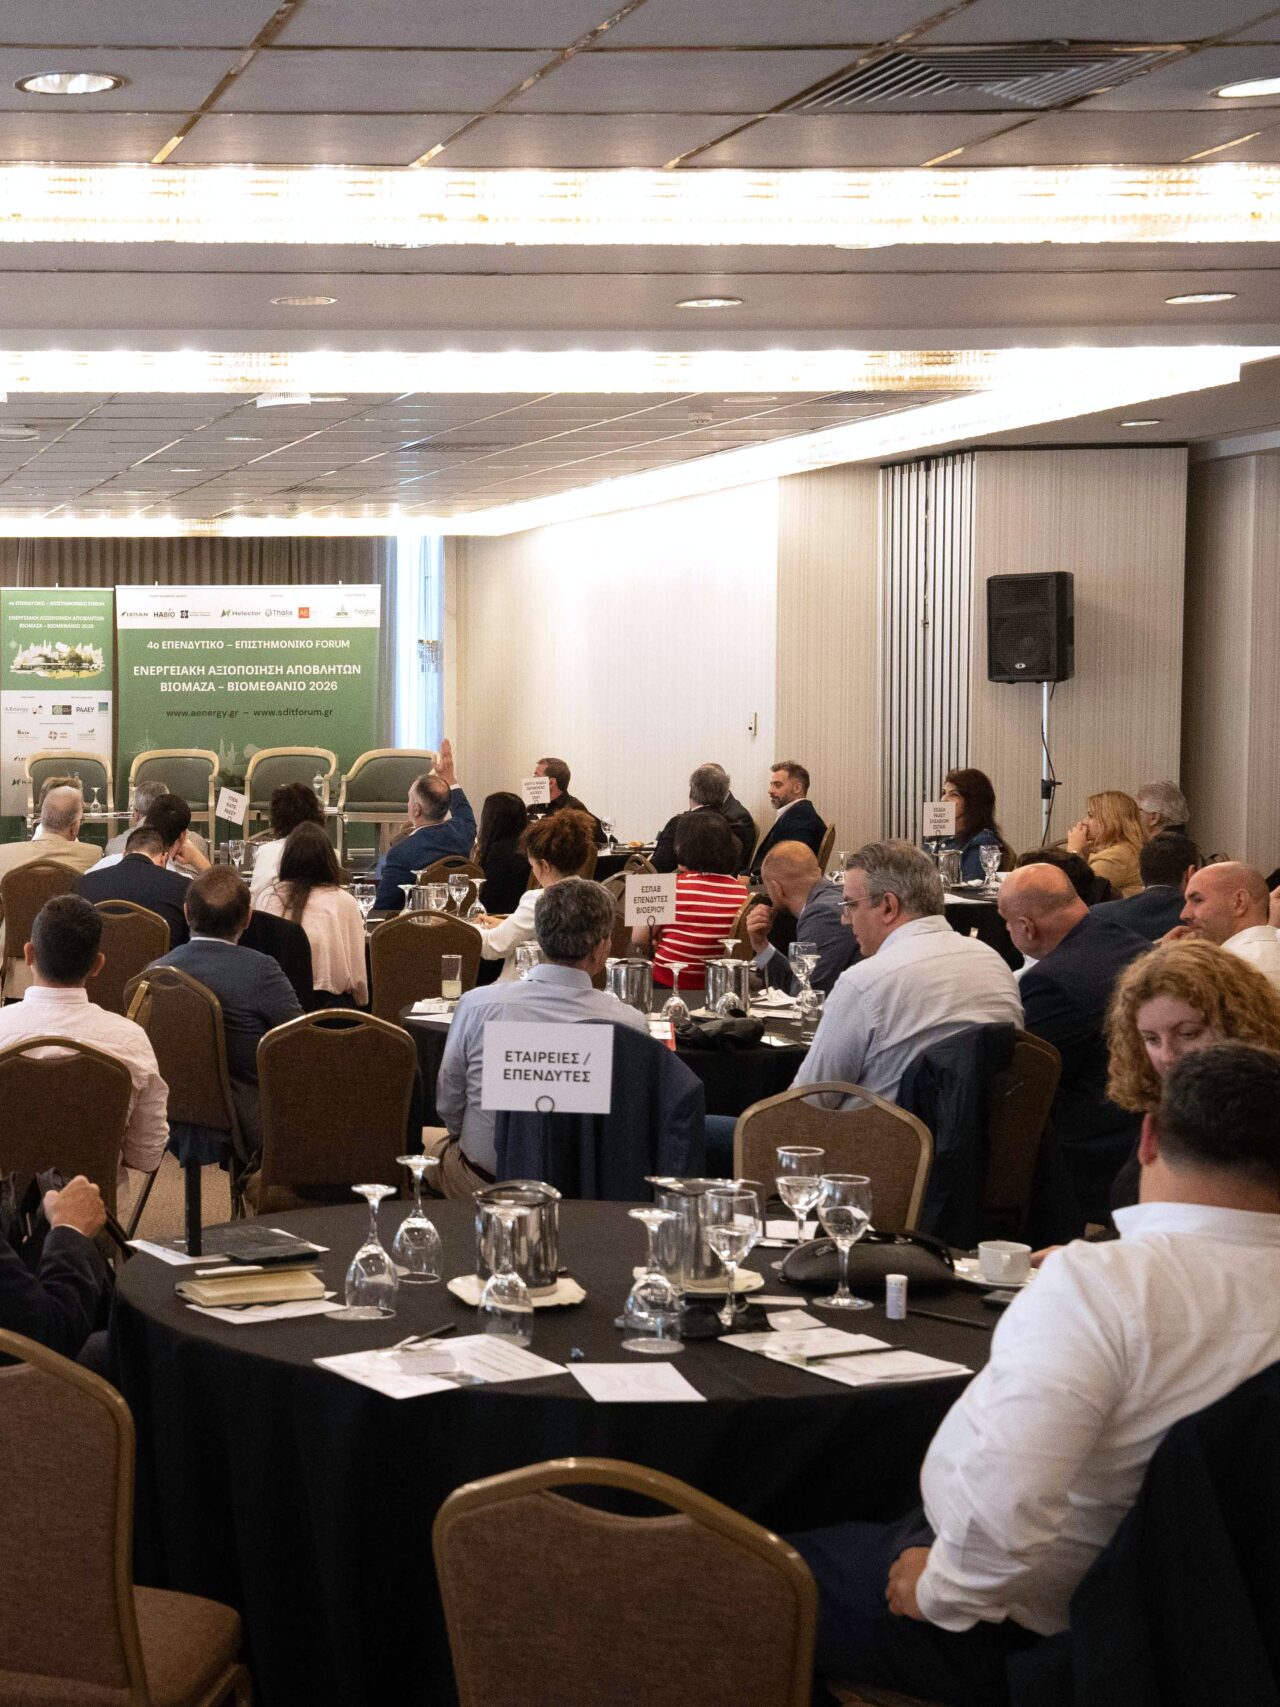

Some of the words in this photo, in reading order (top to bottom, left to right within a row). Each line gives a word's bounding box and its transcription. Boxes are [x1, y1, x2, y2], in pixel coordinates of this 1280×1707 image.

[147, 641, 159, 649] 4ο
[162, 640, 224, 649] ΕΠΕΝΔΥΤΙΚΟ
[235, 640, 313, 649] ΕΠΙΣΤΗΜΟΝΙΚΟ
[316, 640, 350, 648] FORUM
[133, 666, 205, 676] ΕΝΕΡΓΕΙΑΚΗ
[208, 665, 283, 675] ΑΞΙΟΠΟΙΗΣΗ
[286, 664, 361, 675] ΑΠΟΒΛΗΤΩΝ
[160, 682, 216, 692] ΒΙΟΜΑΖΑ
[227, 682, 306, 691] ΒΙΟΜΕΘΑΝΙΟ
[308, 681, 338, 691] 2026
[166, 710, 239, 718] www.aenergy.gr
[253, 708, 333, 718] www.sditforum.gr
[634, 895, 668, 904] ΕΠΕΝΔΥΤΕΣ
[505, 1050, 580, 1064] ΕΤΑΙΡΕΙΕΣ
[503, 1068, 591, 1083] ΕΠΕΝΔΥΤΕΣ
